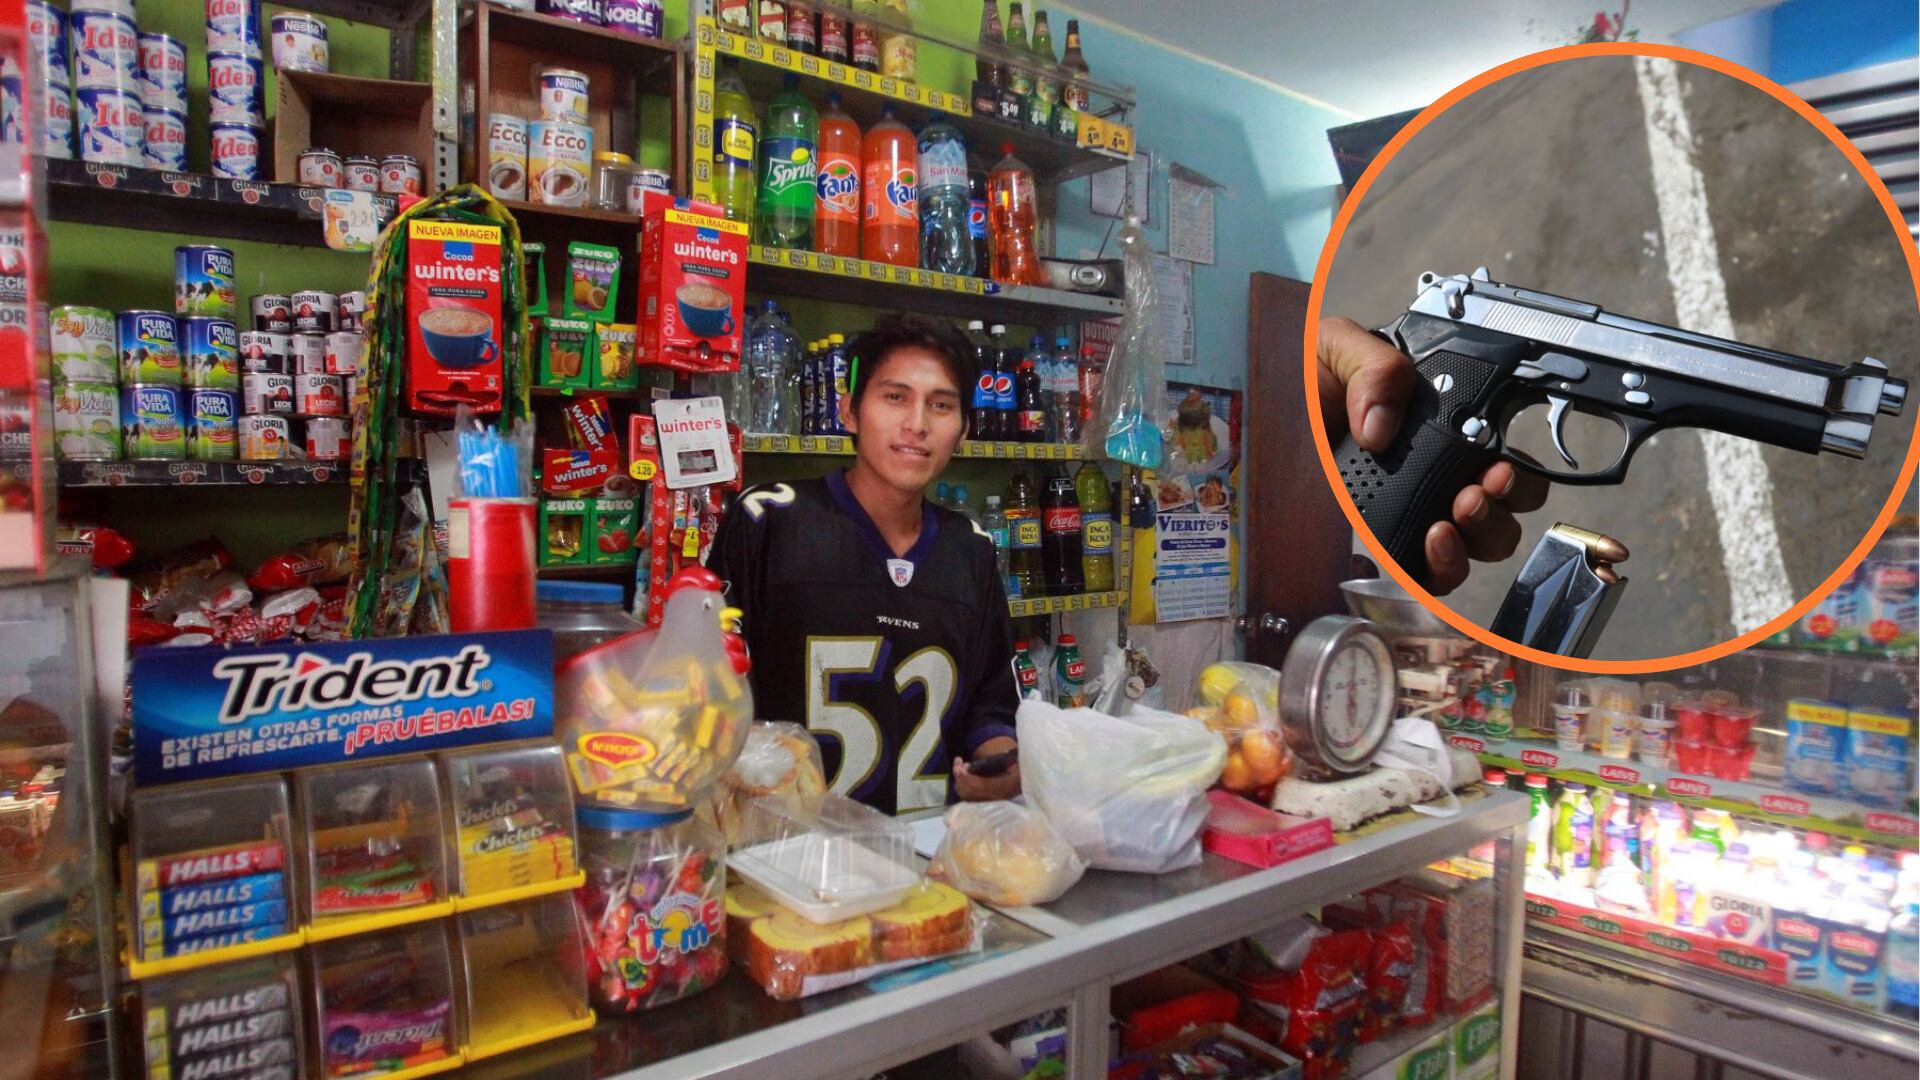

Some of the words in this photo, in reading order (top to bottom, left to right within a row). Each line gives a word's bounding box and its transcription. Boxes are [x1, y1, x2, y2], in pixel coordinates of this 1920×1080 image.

[542, 129, 587, 151] ECCO
[770, 159, 816, 188] Sprite
[676, 213, 705, 226] NUEVA
[706, 217, 738, 232] IMAGEN
[416, 225, 454, 237] NUEVA
[456, 228, 498, 240] IMAGEN
[697, 233, 720, 245] Cocoa
[207, 253, 232, 266] PURA
[443, 251, 474, 262] Cocoa
[674, 241, 738, 265] winter's
[415, 261, 500, 284] winter's
[263, 298, 291, 309] GLORI
[293, 295, 321, 305] GLORIA
[141, 318, 172, 331] PURA
[212, 325, 236, 338] PURA
[148, 327, 174, 341] VIDA
[136, 392, 169, 405] PURA
[143, 401, 172, 413] VIDA
[196, 395, 227, 407] PURA
[201, 404, 229, 416] VIDA
[251, 419, 285, 431] GLORIA
[660, 416, 723, 434] winter's
[555, 463, 608, 484] winter's
[546, 500, 585, 511] ZUKO
[595, 500, 634, 511] ZUKO
[1090, 525, 1109, 534] INCA
[215, 647, 489, 722] Trident
[161, 728, 251, 754] EXISTEN
[259, 718, 321, 739] OTRAS
[327, 705, 404, 728] FORMAS
[344, 697, 535, 755] ¡PRUÉBALAS!
[806, 635, 958, 816] 52
[162, 751, 192, 770] DE
[1524, 752, 1556, 767] LAIVE
[1602, 767, 1639, 782] LAIVE
[1669, 779, 1708, 796] LAIVE
[1763, 795, 1806, 813] LAIVE
[473, 826, 544, 853] Chiclets
[168, 850, 250, 885] HALLS
[171, 884, 252, 914] HALLS
[1711, 896, 1764, 921] GLORIA
[174, 905, 255, 938] HALLS
[176, 991, 256, 1028] HALLS
[178, 1016, 260, 1055] HALLS
[182, 1050, 262, 1080] HALLS
